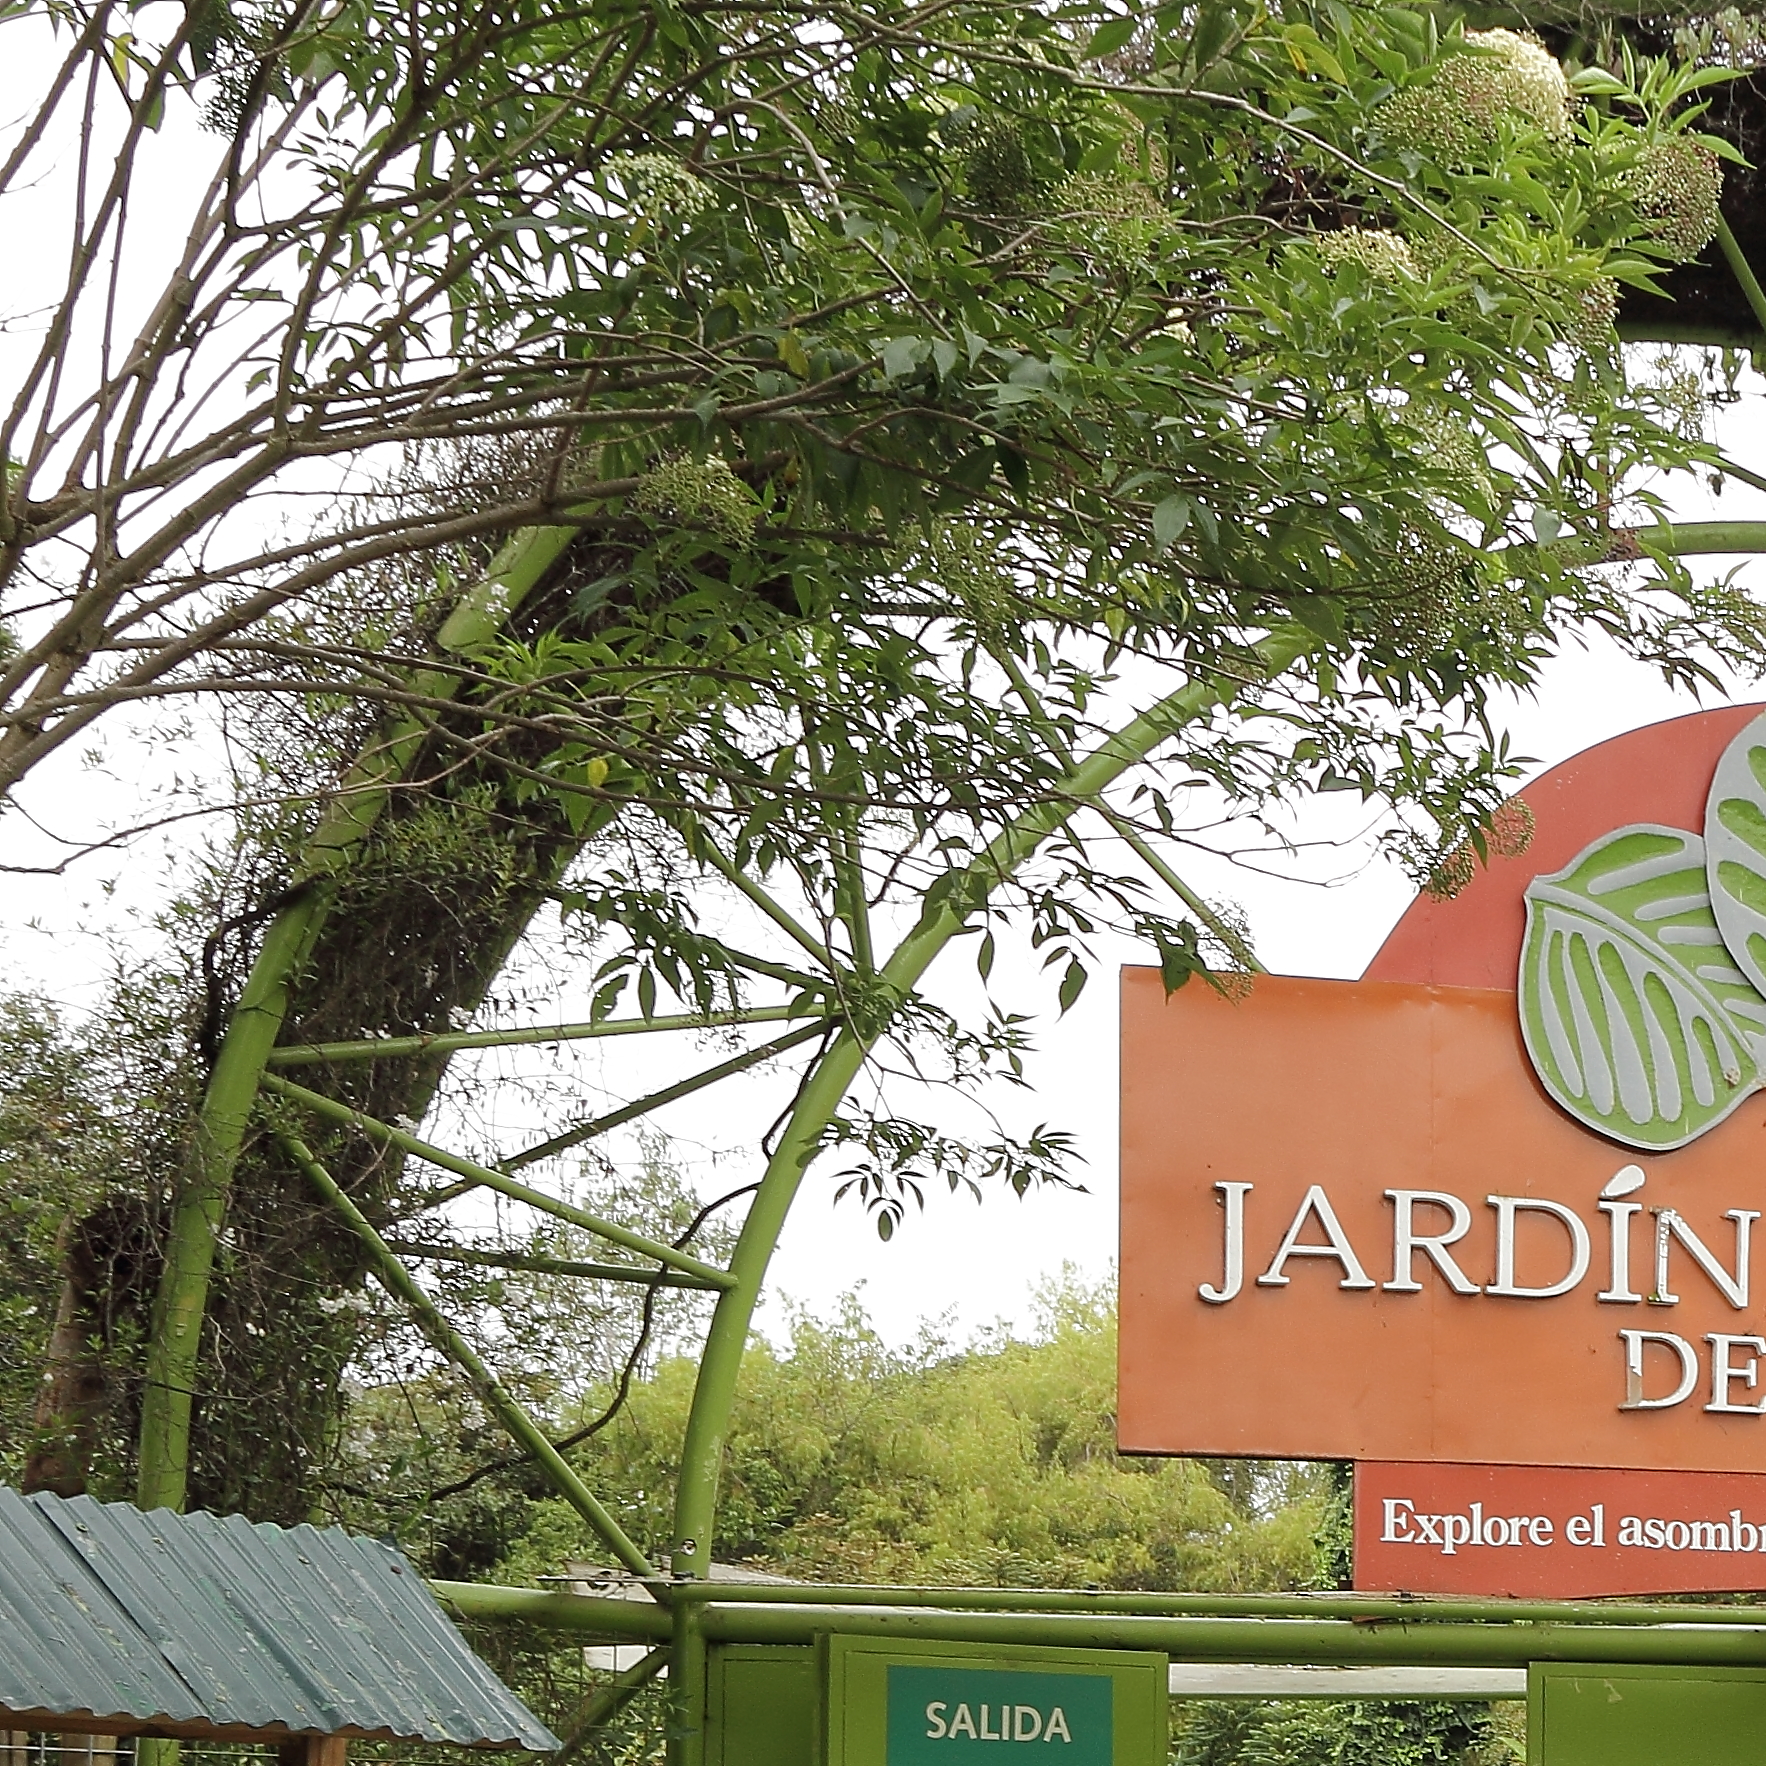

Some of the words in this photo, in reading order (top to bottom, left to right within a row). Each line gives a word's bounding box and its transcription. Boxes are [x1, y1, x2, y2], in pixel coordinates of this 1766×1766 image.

[1198, 1163, 1762, 1310] JARDÍN
[1379, 1498, 1554, 1555] Explore
[1565, 1504, 1606, 1548] el
[925, 1701, 1072, 1744] SALIDA
